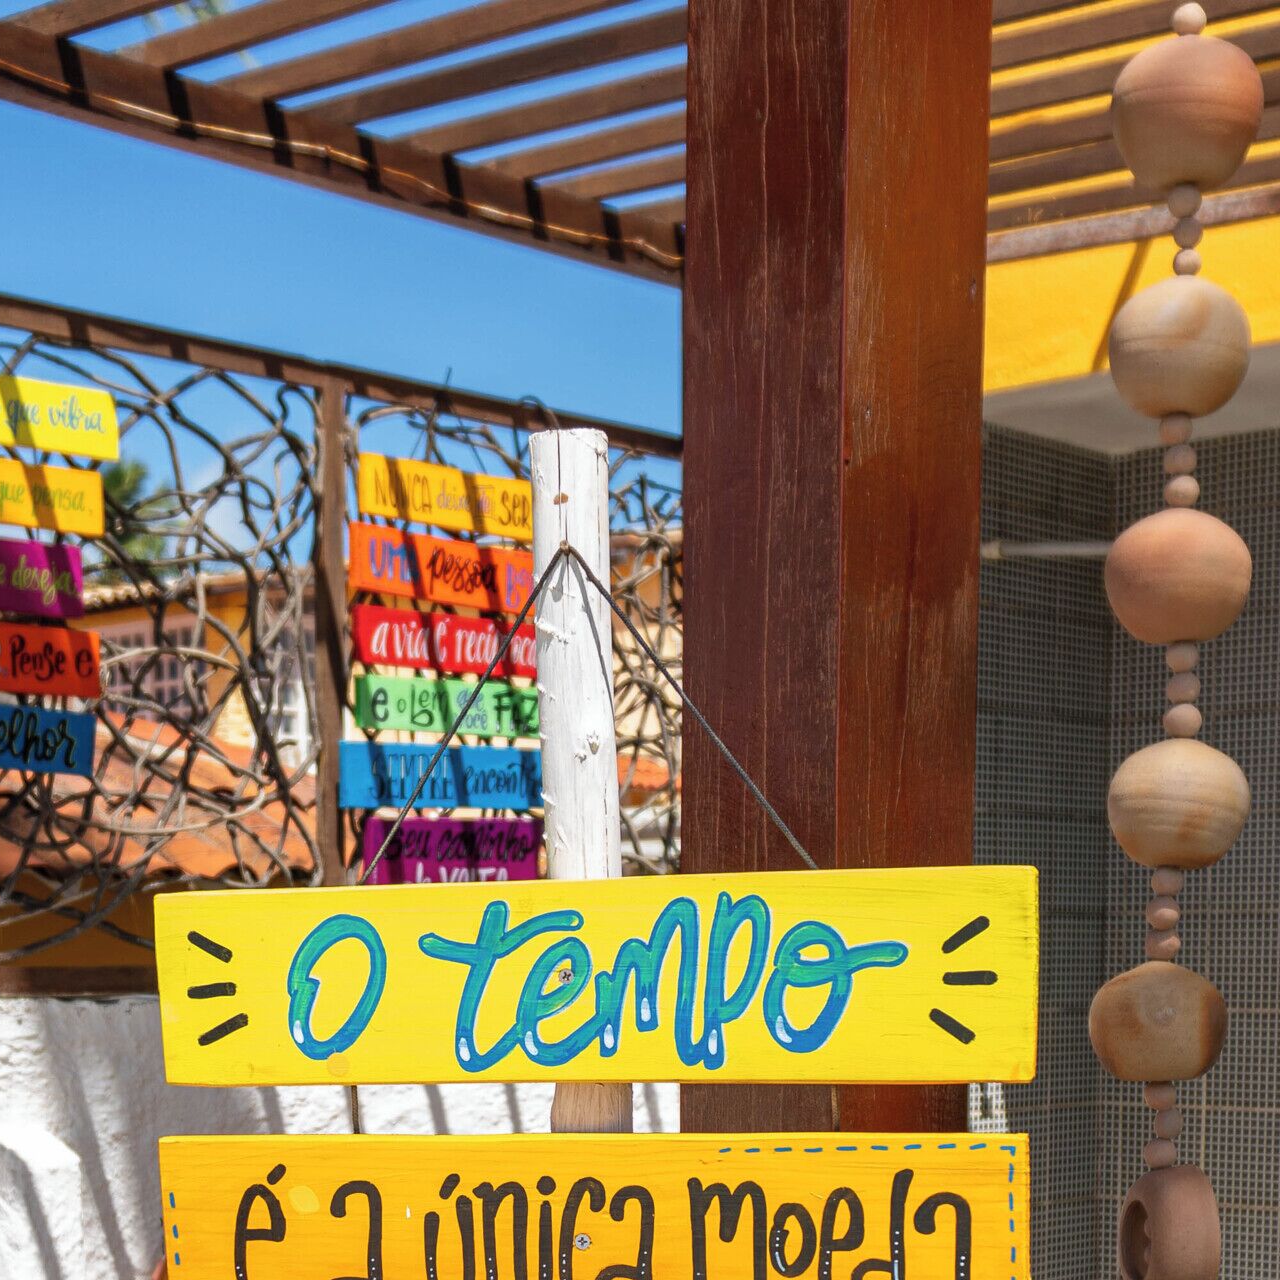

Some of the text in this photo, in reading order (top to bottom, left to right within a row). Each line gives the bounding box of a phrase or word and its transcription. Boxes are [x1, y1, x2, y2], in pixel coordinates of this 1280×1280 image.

[5, 399, 41, 436] que
[371, 621, 389, 658] a
[392, 621, 431, 661] via
[417, 890, 910, 1073] tempo
